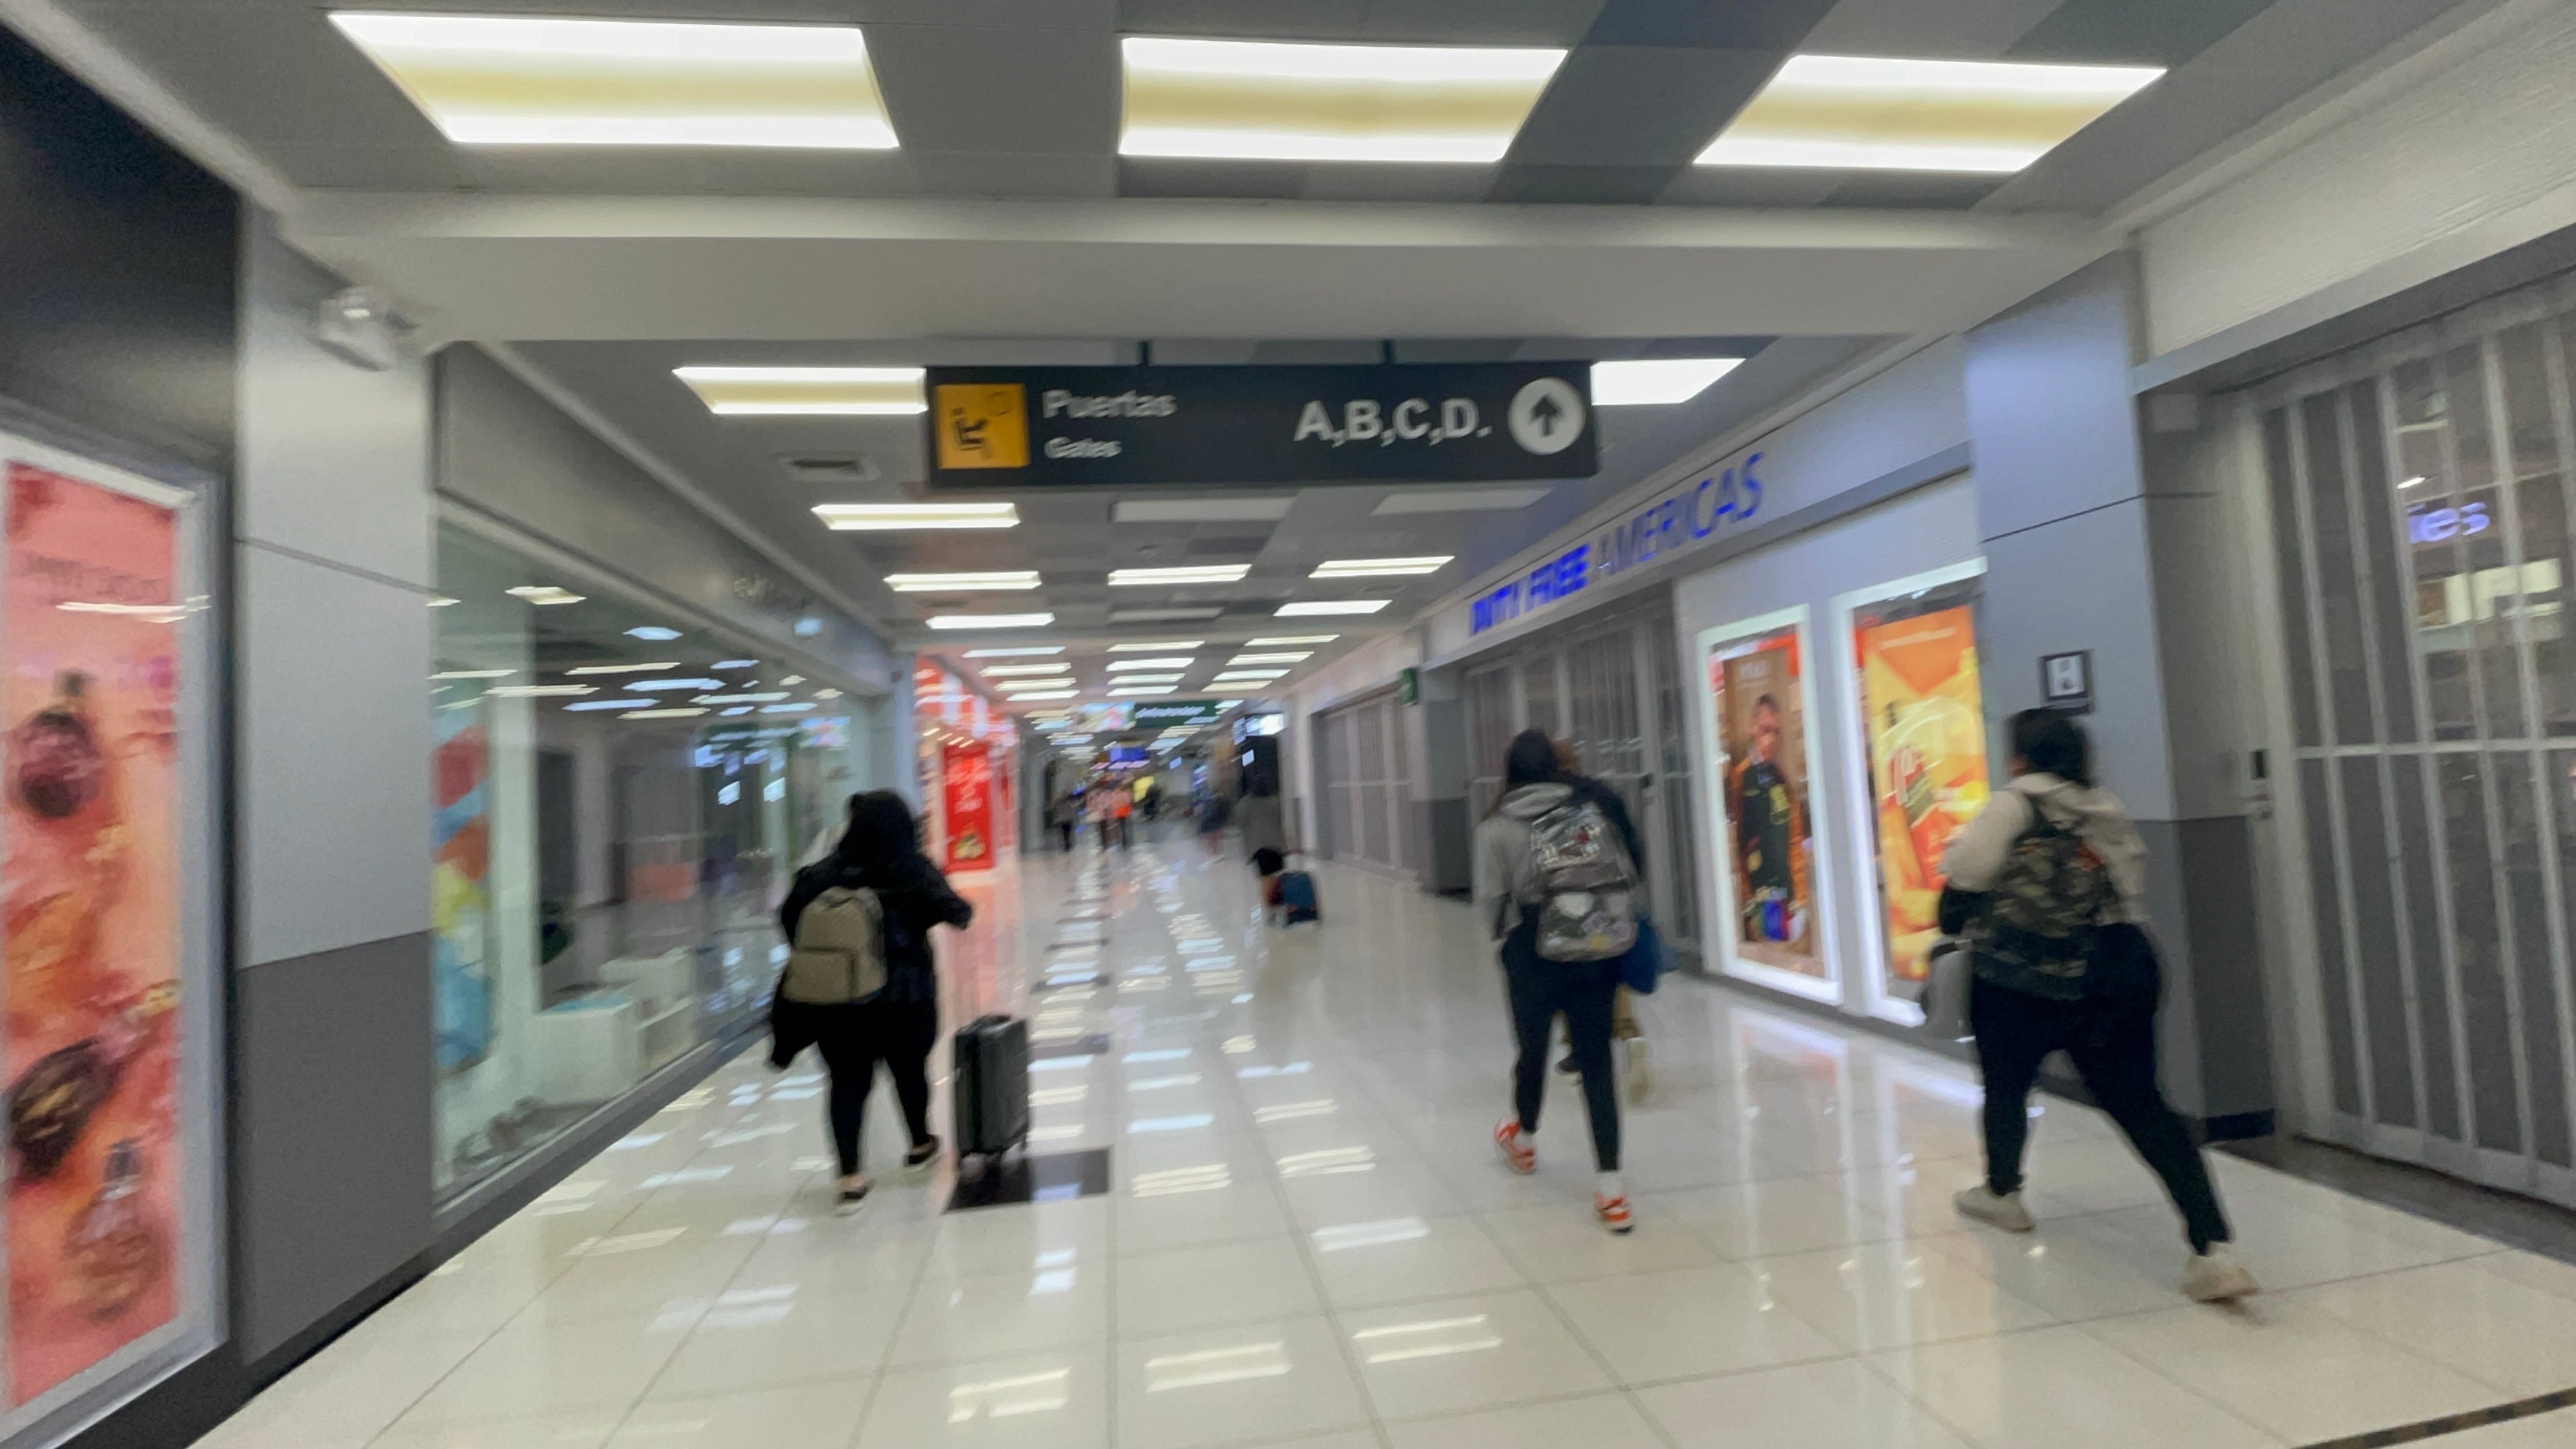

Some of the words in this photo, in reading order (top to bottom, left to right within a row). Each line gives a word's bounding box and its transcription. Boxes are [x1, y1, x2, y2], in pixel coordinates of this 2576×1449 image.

[1042, 389, 1177, 419] Puertas
[1044, 436, 1123, 459] Gates
[1469, 581, 1521, 637] DUTY
[1524, 543, 1591, 613] FREE
[1592, 451, 1765, 583] AMERICAS
